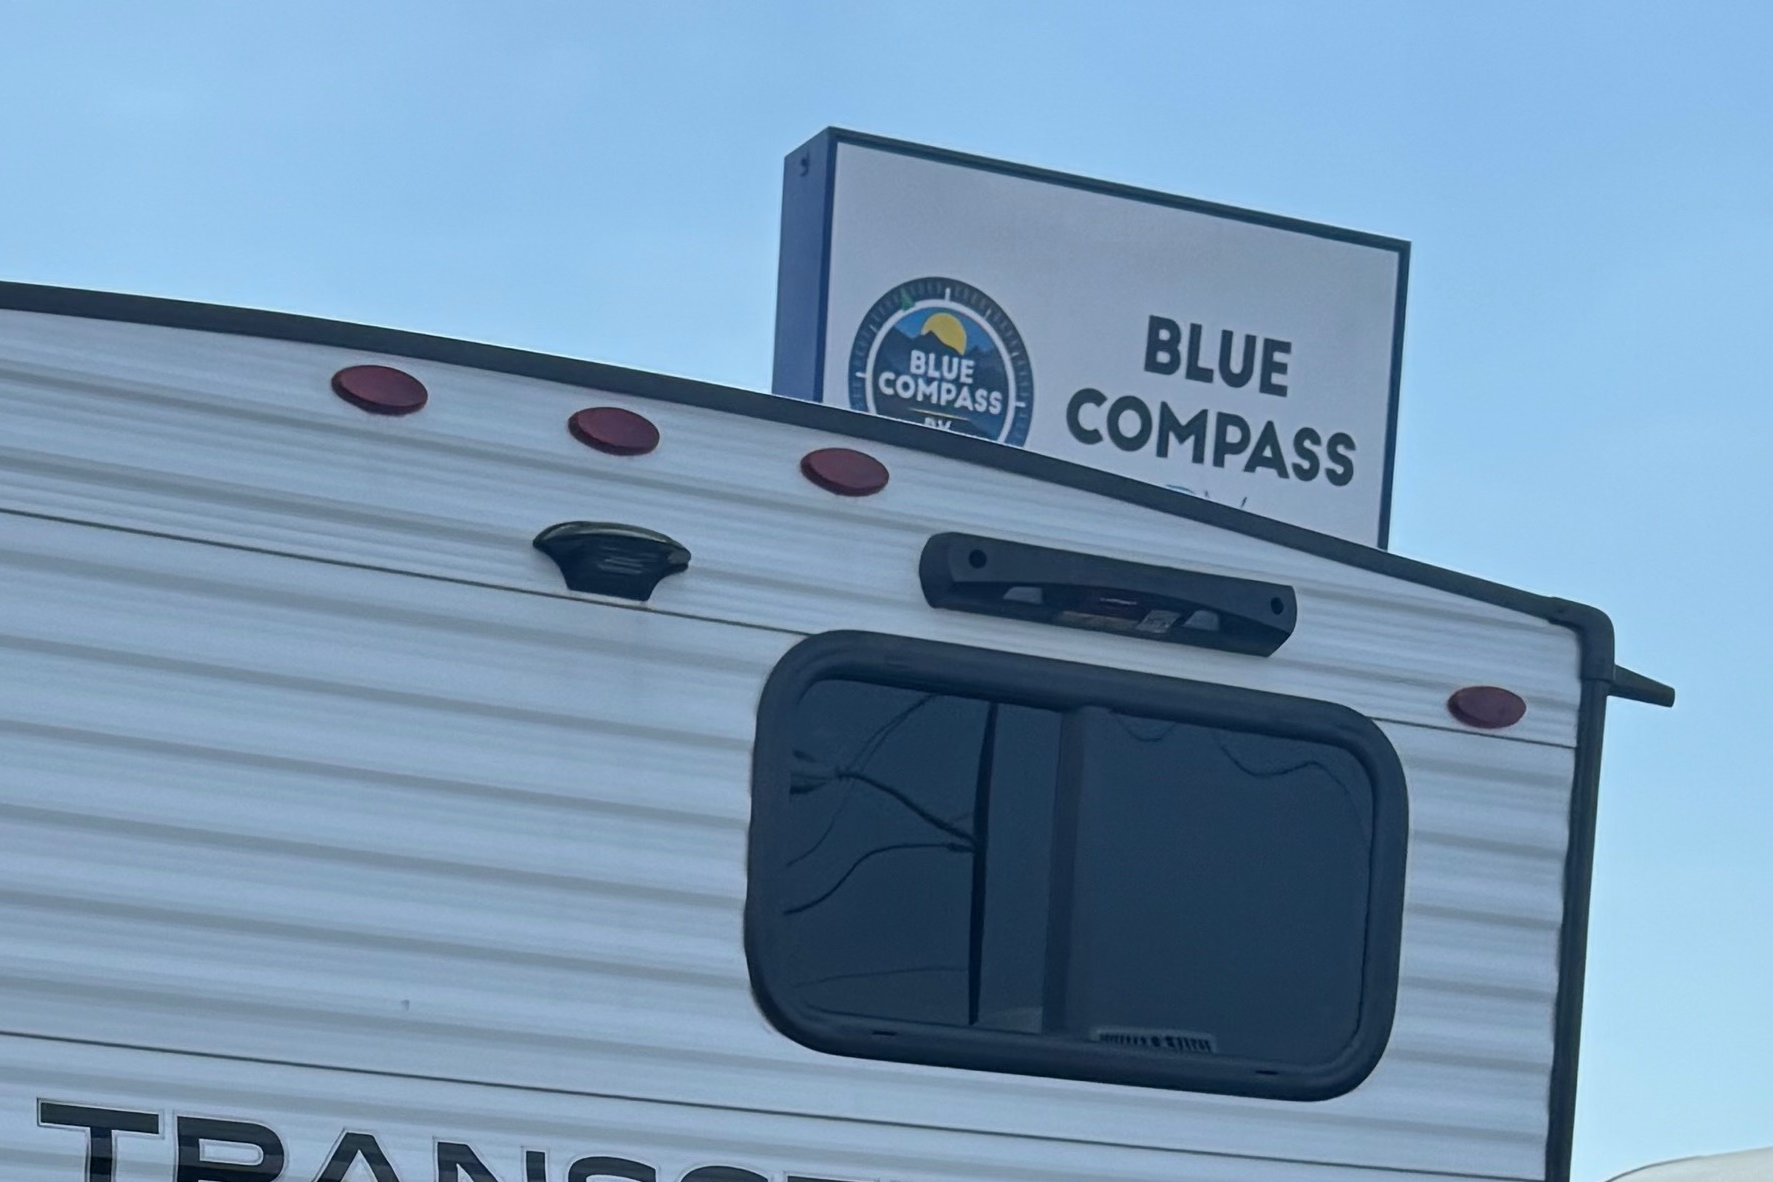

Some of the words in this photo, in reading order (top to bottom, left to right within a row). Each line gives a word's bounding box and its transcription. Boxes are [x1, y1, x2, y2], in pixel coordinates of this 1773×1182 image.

[909, 350, 975, 384] BLUE
[1144, 314, 1293, 397] BLUE
[878, 371, 1003, 415] COMPASS
[1066, 387, 1358, 487] COMPASS
